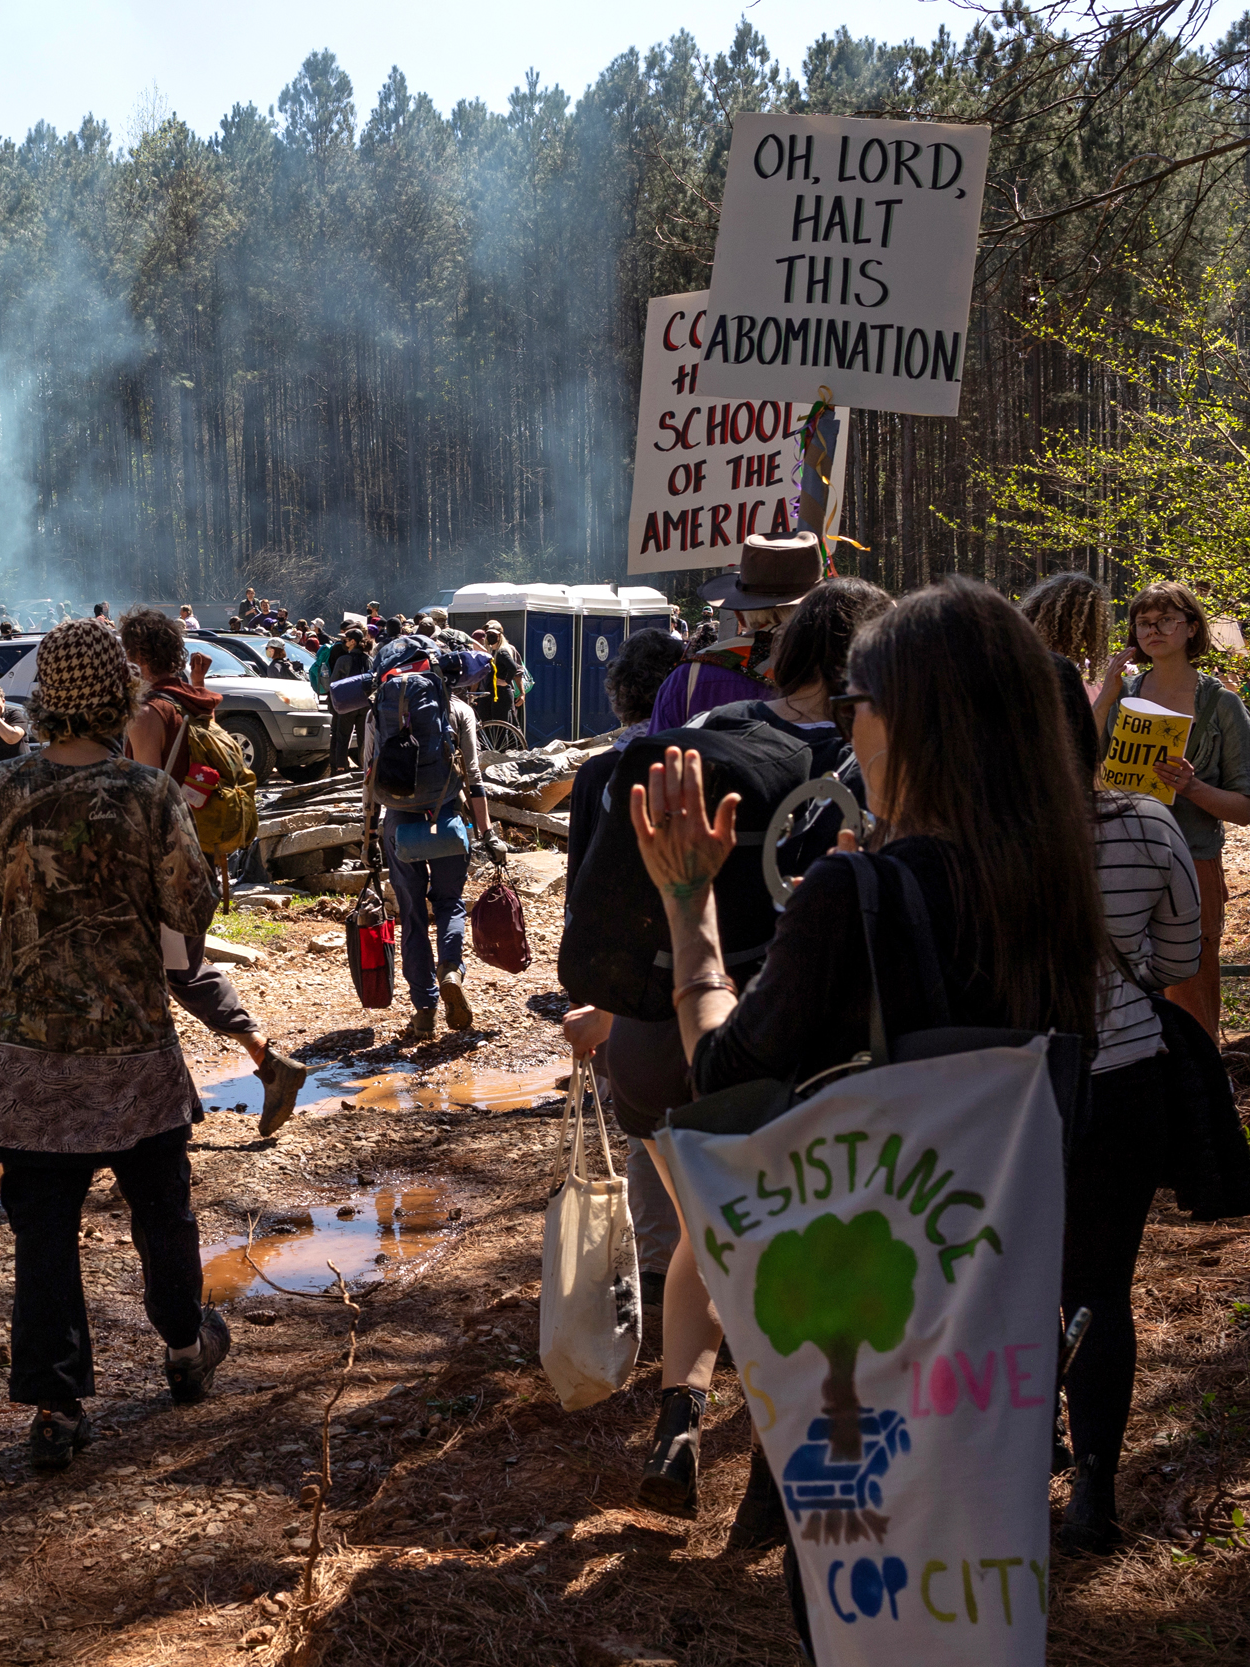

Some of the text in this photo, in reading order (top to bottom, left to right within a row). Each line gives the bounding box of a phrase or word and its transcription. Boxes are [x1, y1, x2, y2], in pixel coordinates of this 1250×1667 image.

[753, 133, 966, 199] OH, LORD,
[792, 194, 903, 248] HALT
[775, 253, 890, 308] THIS
[653, 400, 801, 452] SCHOOL
[667, 449, 783, 497] OF THE
[640, 497, 800, 554] AMERICA
[1122, 714, 1153, 735] FOR
[911, 1343, 1047, 1420] LOVE
[827, 1555, 1049, 1627] COP CITY
